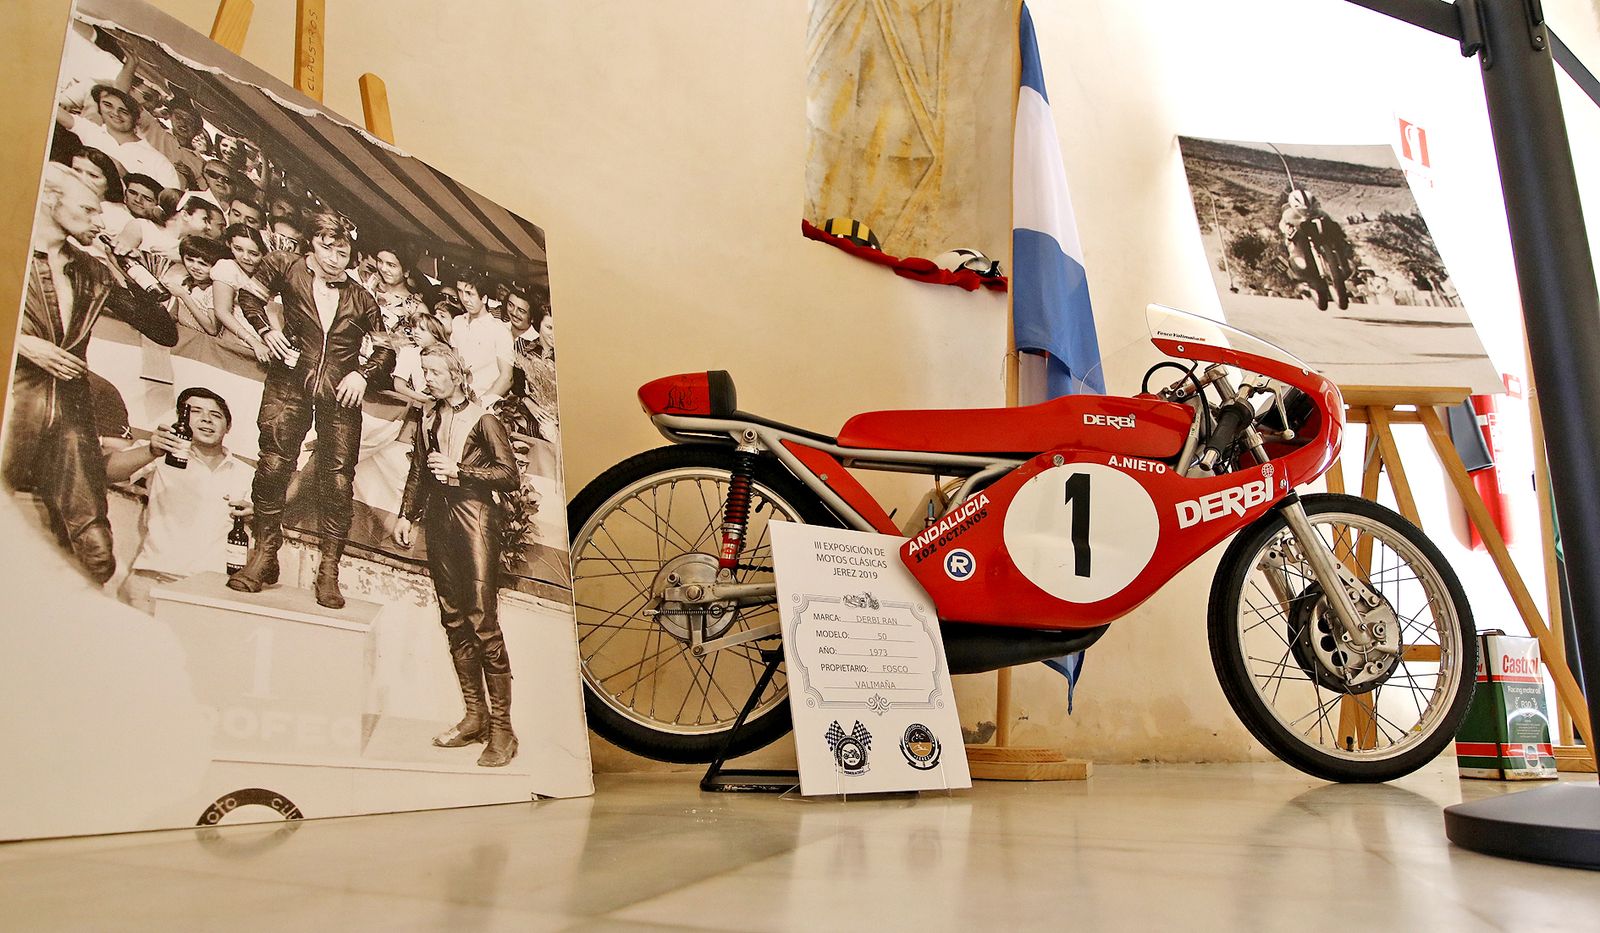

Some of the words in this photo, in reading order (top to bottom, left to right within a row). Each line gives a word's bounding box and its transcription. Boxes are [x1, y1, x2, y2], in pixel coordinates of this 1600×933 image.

[306, 9, 318, 91] CLAUSTROS
[1108, 455, 1166, 474] A.NIETO
[909, 494, 991, 556] ANDALUCIA
[1065, 473, 1091, 578] 1
[915, 543, 937, 563] 102
[938, 508, 988, 547] OCTANOS
[814, 541, 822, 550] III
[823, 542, 873, 555] EXPOSICIÓN
[874, 548, 886, 557] DE
[816, 553, 848, 565] MOTOS
[849, 557, 888, 569] CLÁSICAS
[833, 567, 857, 578] JEREZ
[859, 569, 878, 580] 2019
[813, 613, 841, 622] MARCA:
[856, 615, 880, 625] DERBI
[882, 617, 898, 625] RAN
[815, 630, 850, 639] MODELO:
[877, 632, 888, 641] 50
[818, 645, 837, 655] AÑO:
[869, 648, 888, 657] 1973
[820, 663, 869, 673] PROPIETARIO:
[882, 664, 909, 674] FOSCO
[855, 680, 897, 689] VALIMAÑA
[202, 797, 238, 824] oto
